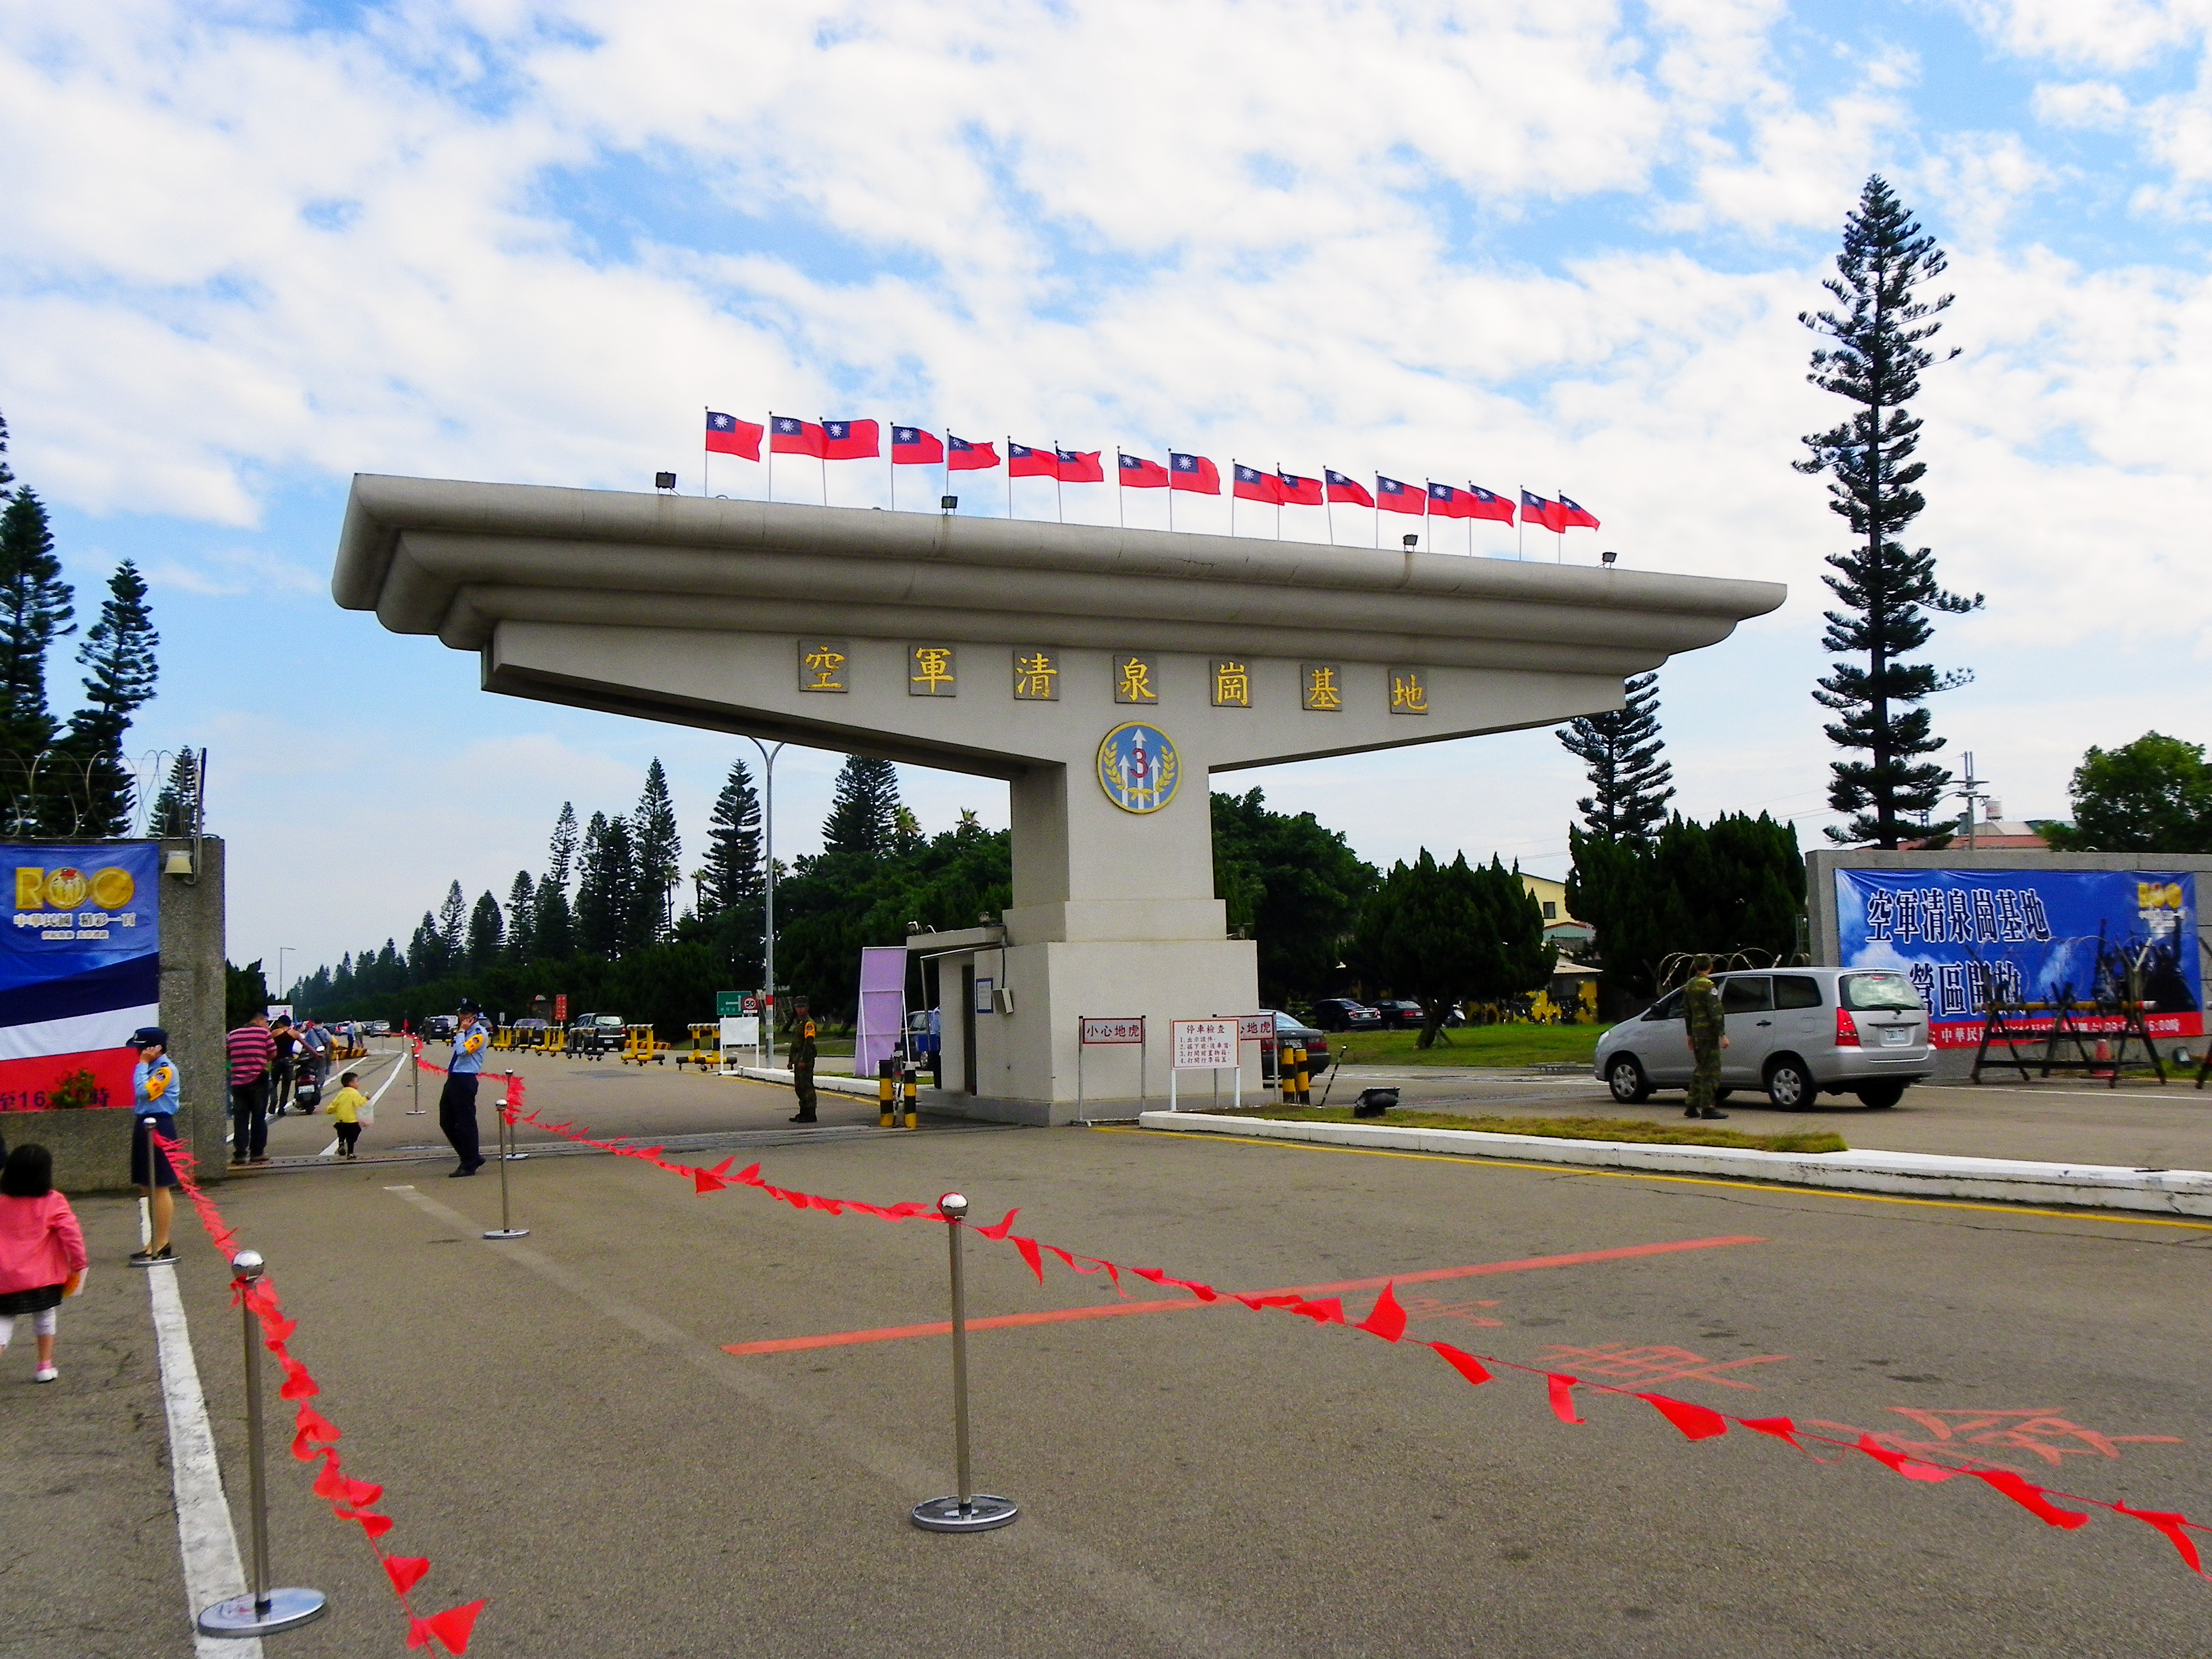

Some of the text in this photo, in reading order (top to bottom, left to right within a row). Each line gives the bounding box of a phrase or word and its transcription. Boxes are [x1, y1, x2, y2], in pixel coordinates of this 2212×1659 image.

[805, 645, 1428, 710] 空軍清泉崗基地
[1130, 748, 1149, 779] 3
[1865, 888, 2053, 943] 空軍清泉崗基地
[1087, 1024, 1140, 1037] 小心地虎
[1186, 1024, 1225, 1034] 停車檢查
